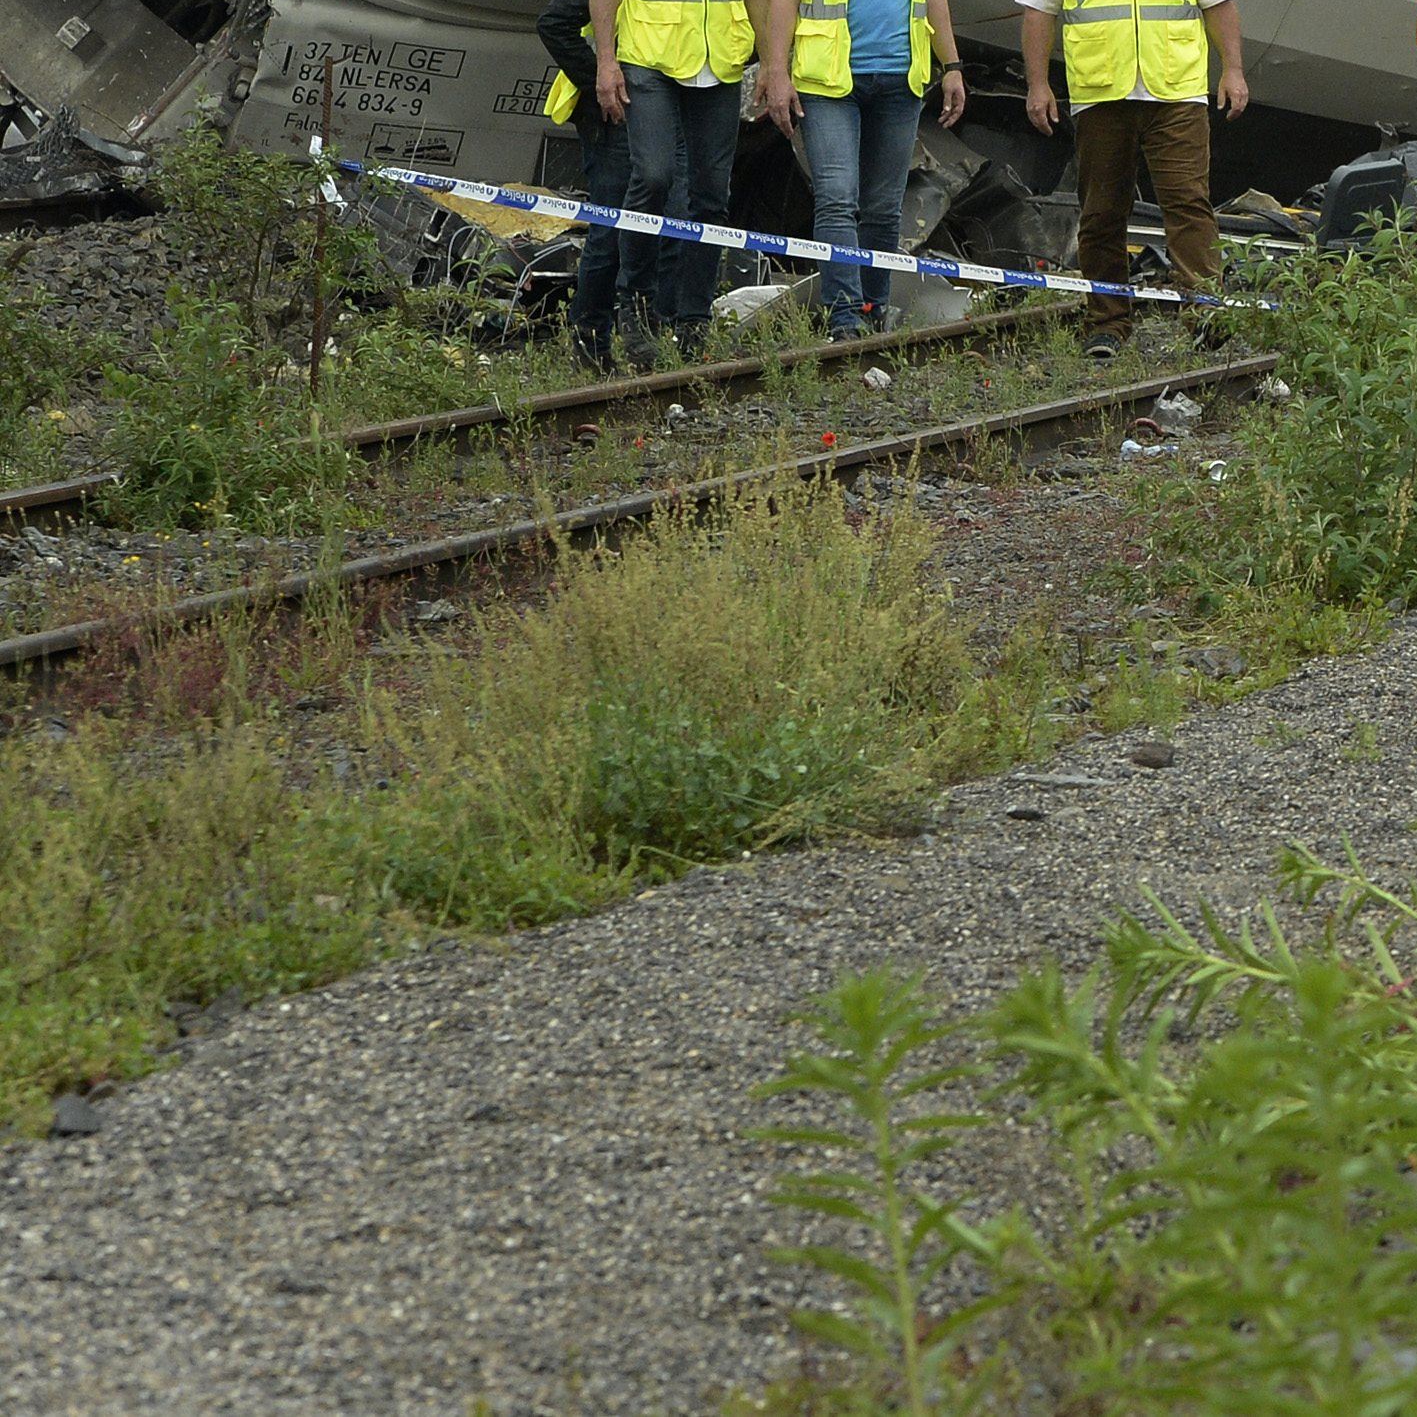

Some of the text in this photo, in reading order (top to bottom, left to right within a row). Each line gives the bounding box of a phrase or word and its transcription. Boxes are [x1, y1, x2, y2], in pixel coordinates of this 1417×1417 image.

[304, 41, 382, 66] 37 TEN
[407, 48, 446, 72] GE
[298, 64, 432, 95] 84 NL-ERSA
[522, 83, 534, 96] S
[291, 85, 424, 117] 664 834-9
[460, 182, 486, 195] Police
[501, 189, 526, 202] Police
[542, 198, 568, 210] Police
[583, 203, 609, 218] Police
[624, 213, 650, 224] Police
[666, 218, 691, 231] Police
